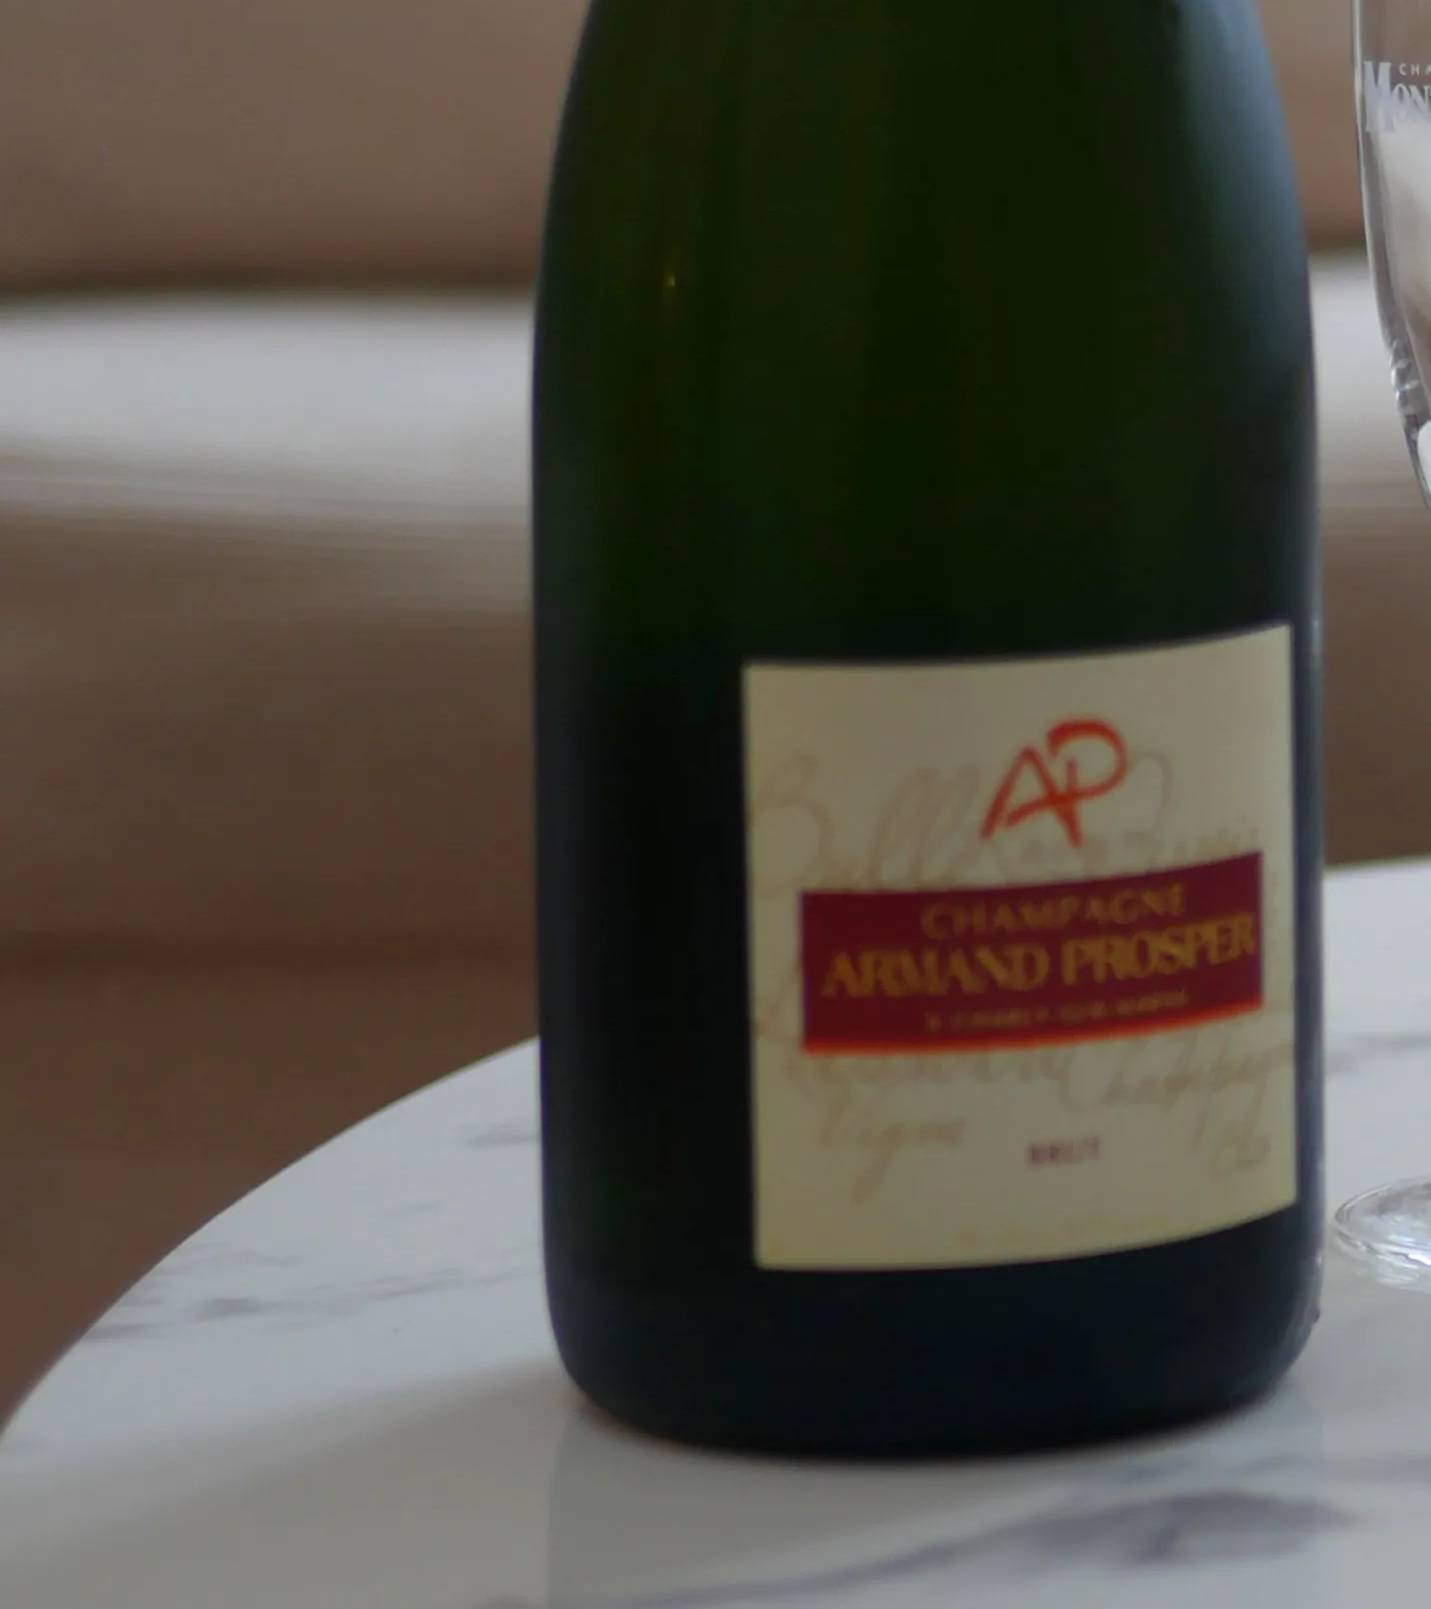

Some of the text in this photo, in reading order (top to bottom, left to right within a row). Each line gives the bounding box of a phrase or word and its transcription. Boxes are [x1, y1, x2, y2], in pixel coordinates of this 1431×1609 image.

[921, 883, 1185, 940] CHAMPAGNE
[824, 912, 1256, 998] ARMAND PROSPER
